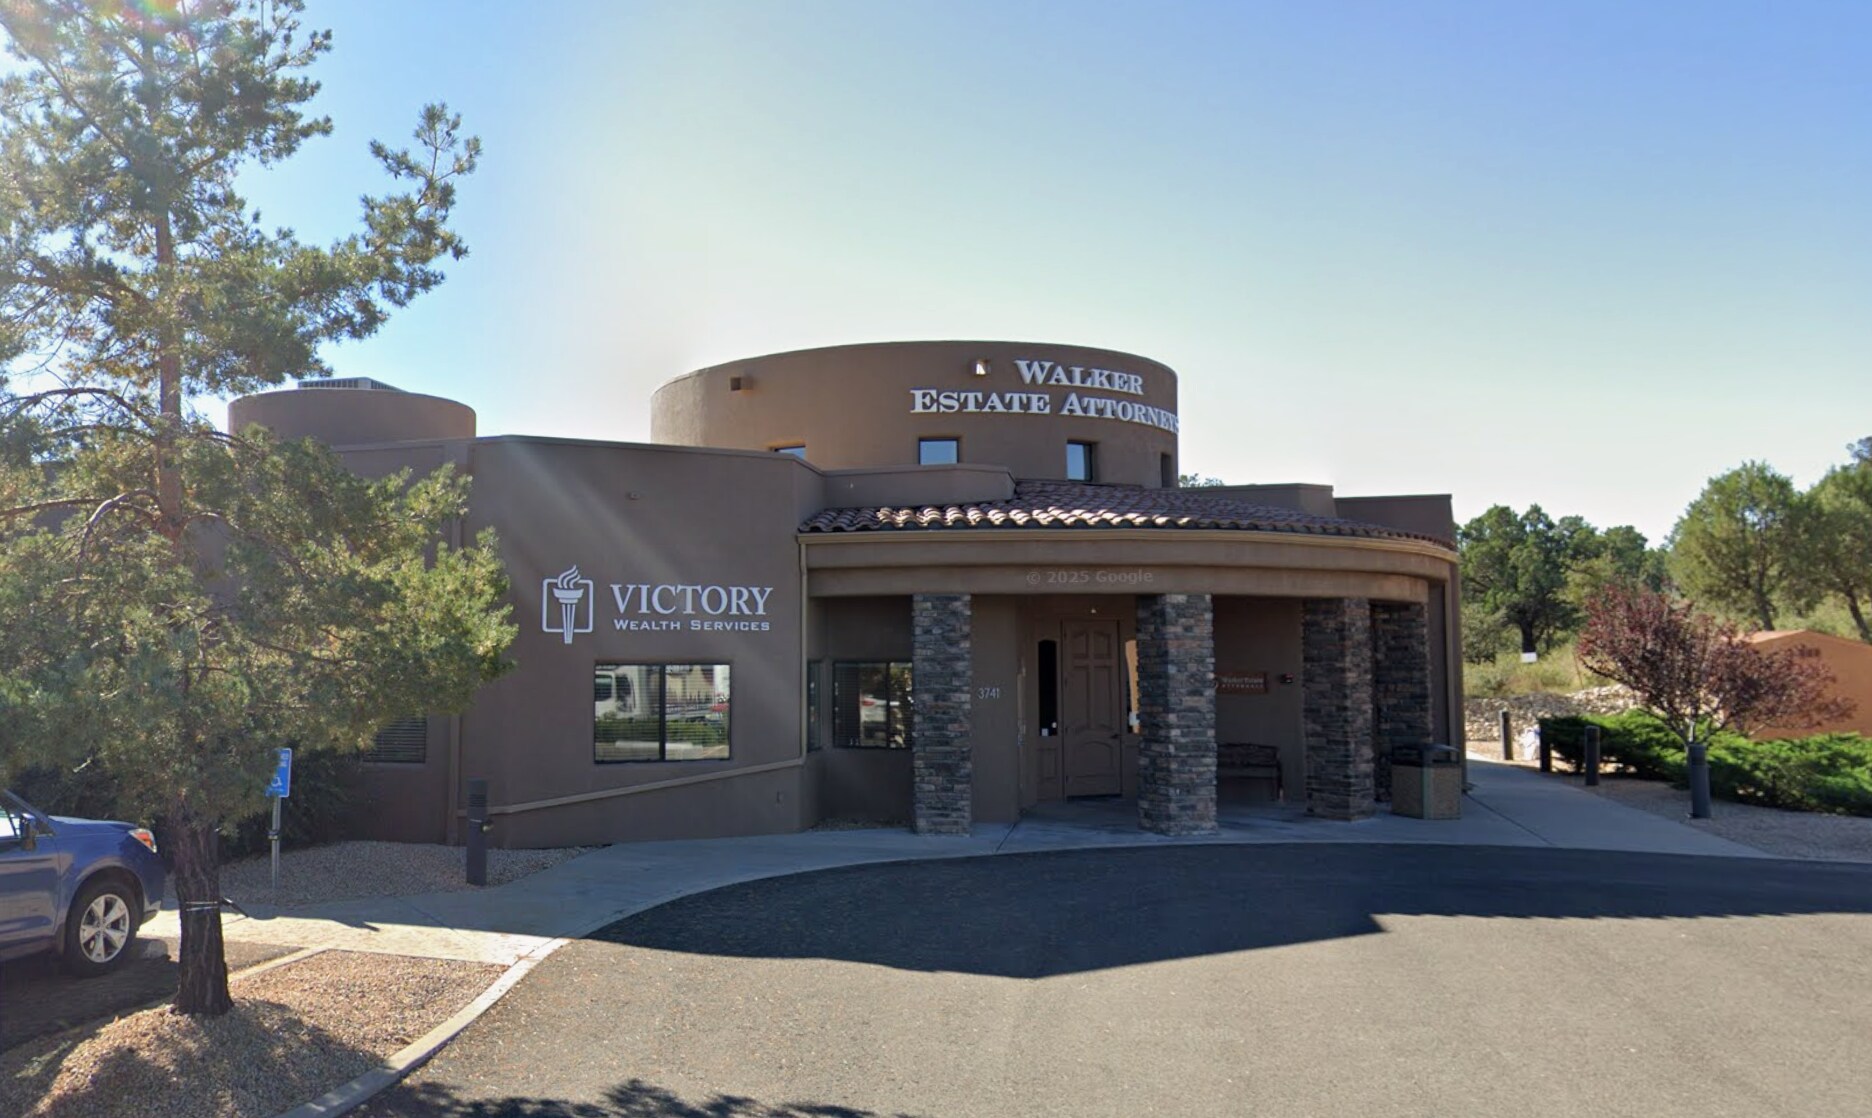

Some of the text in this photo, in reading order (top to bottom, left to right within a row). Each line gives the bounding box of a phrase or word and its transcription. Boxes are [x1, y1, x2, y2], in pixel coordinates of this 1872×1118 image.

[1015, 360, 1143, 395] WALKER
[911, 389, 1050, 414] ESTATE
[610, 584, 773, 615] VICTORY
[614, 619, 770, 631] WEALTH SERVICES
[977, 687, 999, 699] 3741
